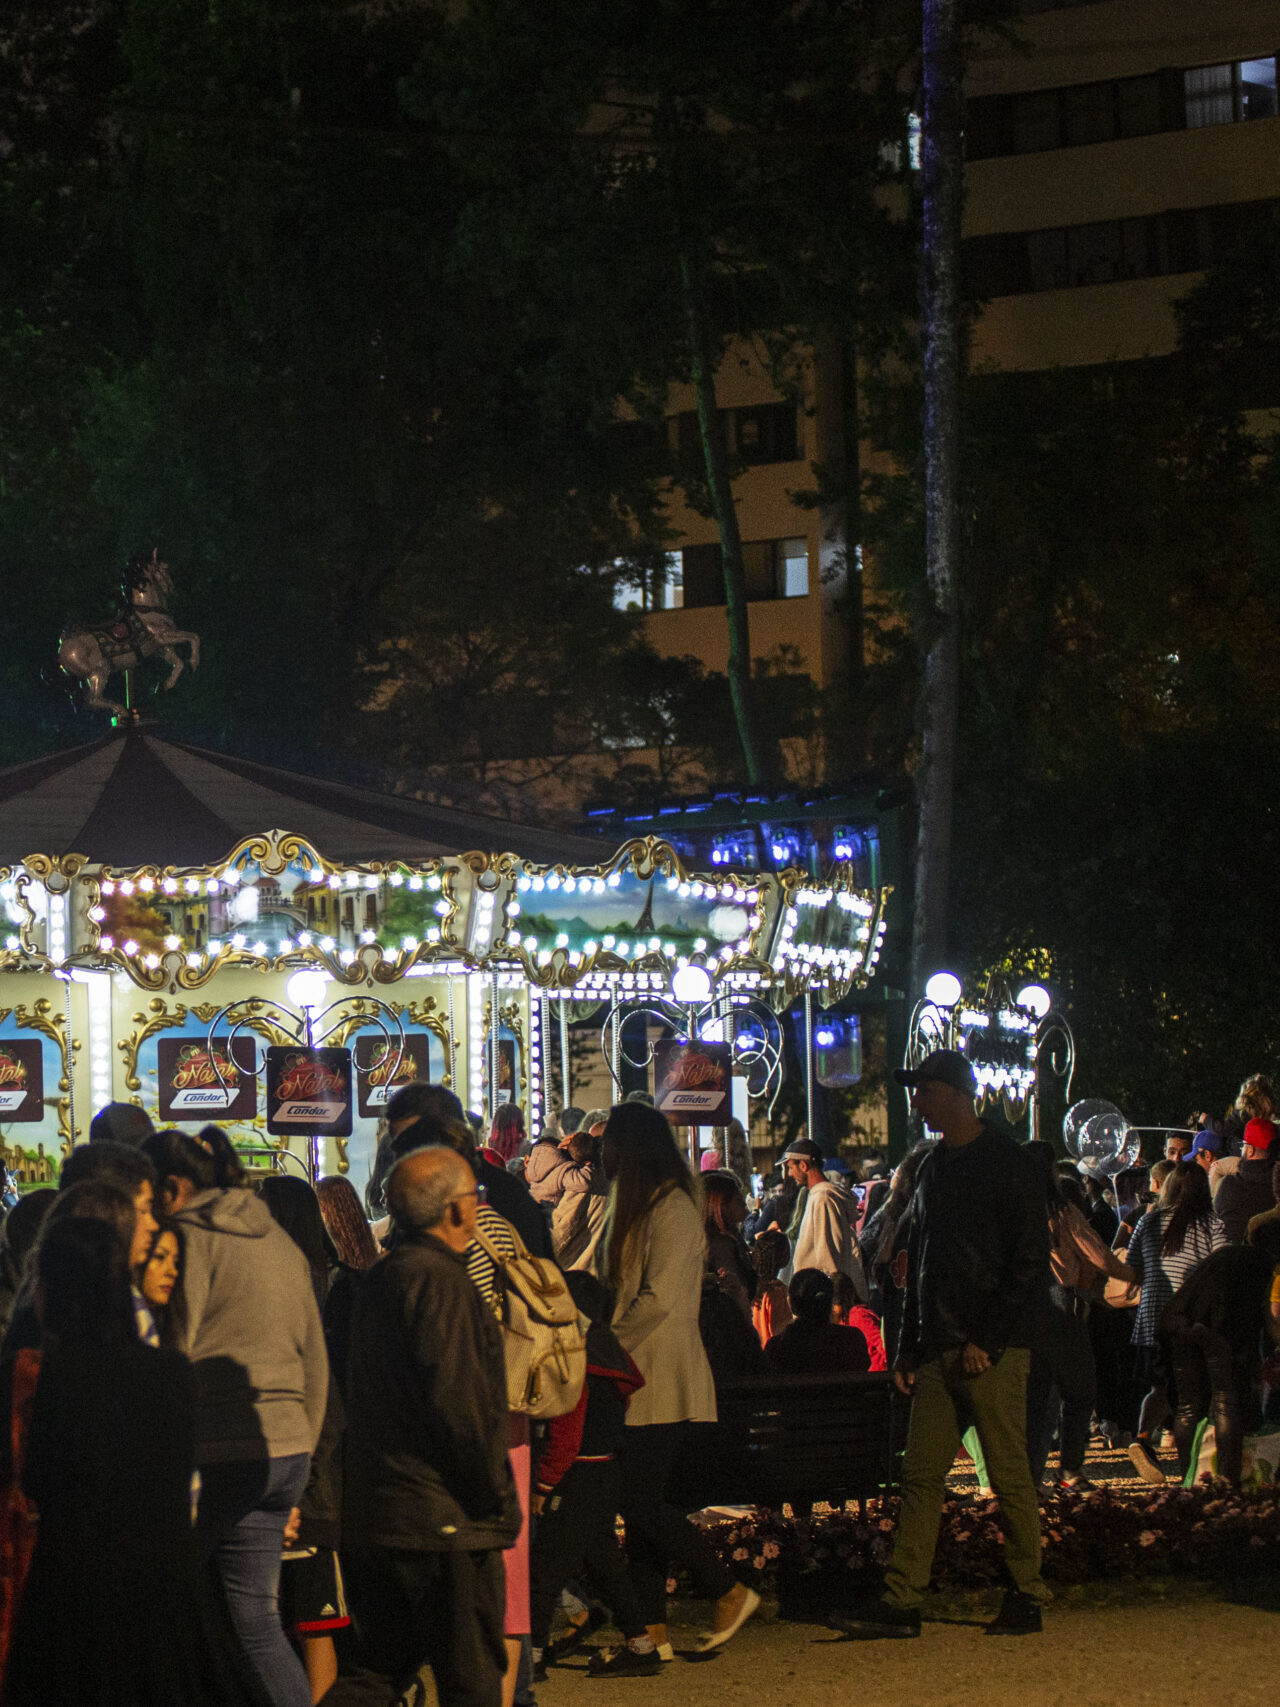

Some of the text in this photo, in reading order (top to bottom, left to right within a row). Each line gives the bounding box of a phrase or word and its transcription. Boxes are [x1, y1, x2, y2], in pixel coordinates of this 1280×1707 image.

[368, 1054, 415, 1086] Naal
[663, 1059, 721, 1090] Natal
[276, 1067, 341, 1100] Natal
[183, 1093, 224, 1102] Condor
[672, 1094, 711, 1104] Condor
[286, 1105, 330, 1116] Condor
